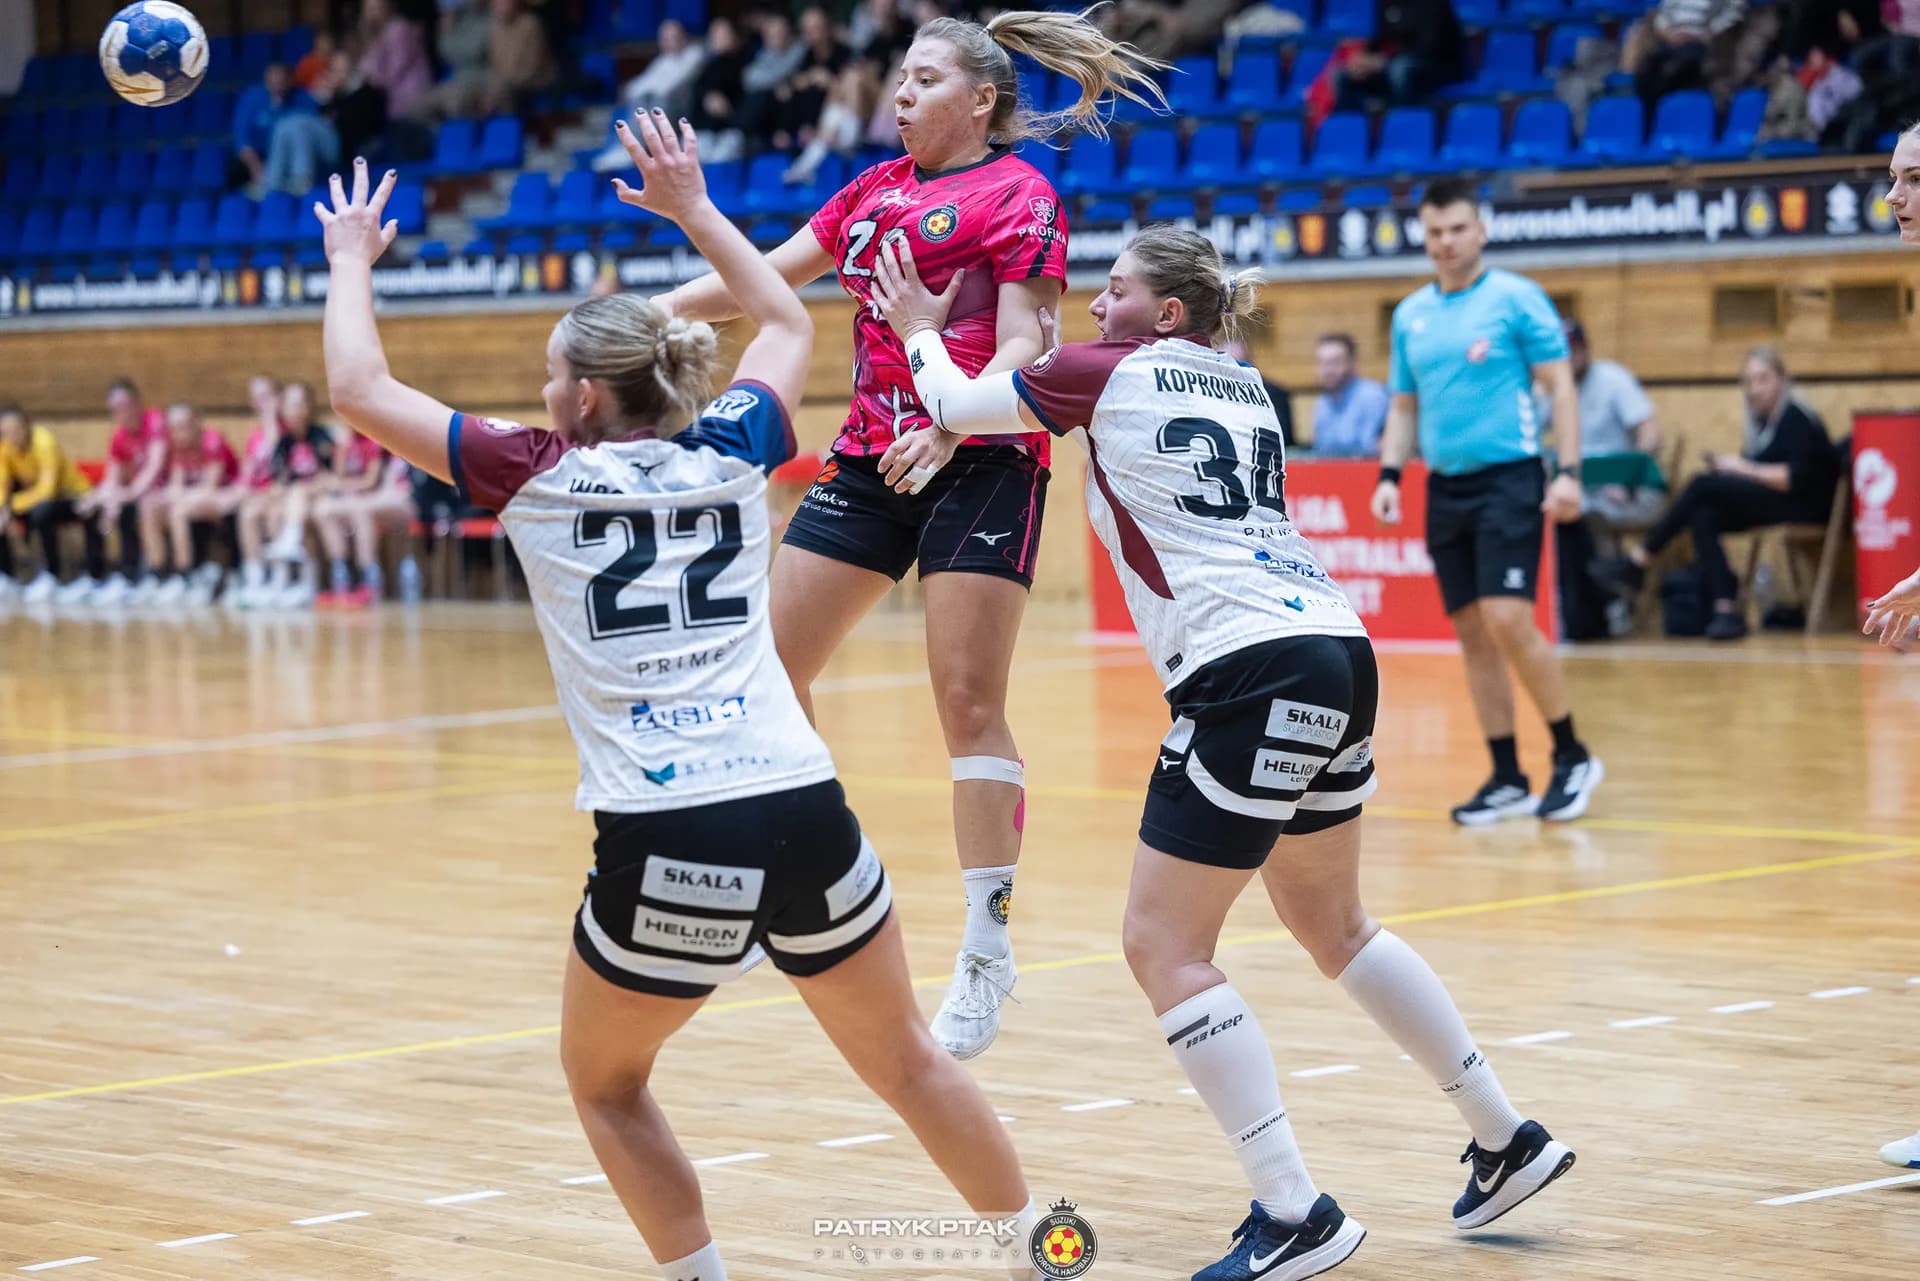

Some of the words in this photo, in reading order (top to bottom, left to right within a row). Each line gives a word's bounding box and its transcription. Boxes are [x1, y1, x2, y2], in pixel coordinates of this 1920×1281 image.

[1017, 225, 1067, 246] PROFIKA
[1153, 367, 1270, 409] KOPROWSKA
[1156, 416, 1289, 521] 34
[574, 502, 748, 642] 22
[1286, 708, 1341, 733] SKALA
[664, 867, 743, 891] SKALA
[645, 917, 739, 941] HELION
[1210, 1013, 1244, 1036] cep
